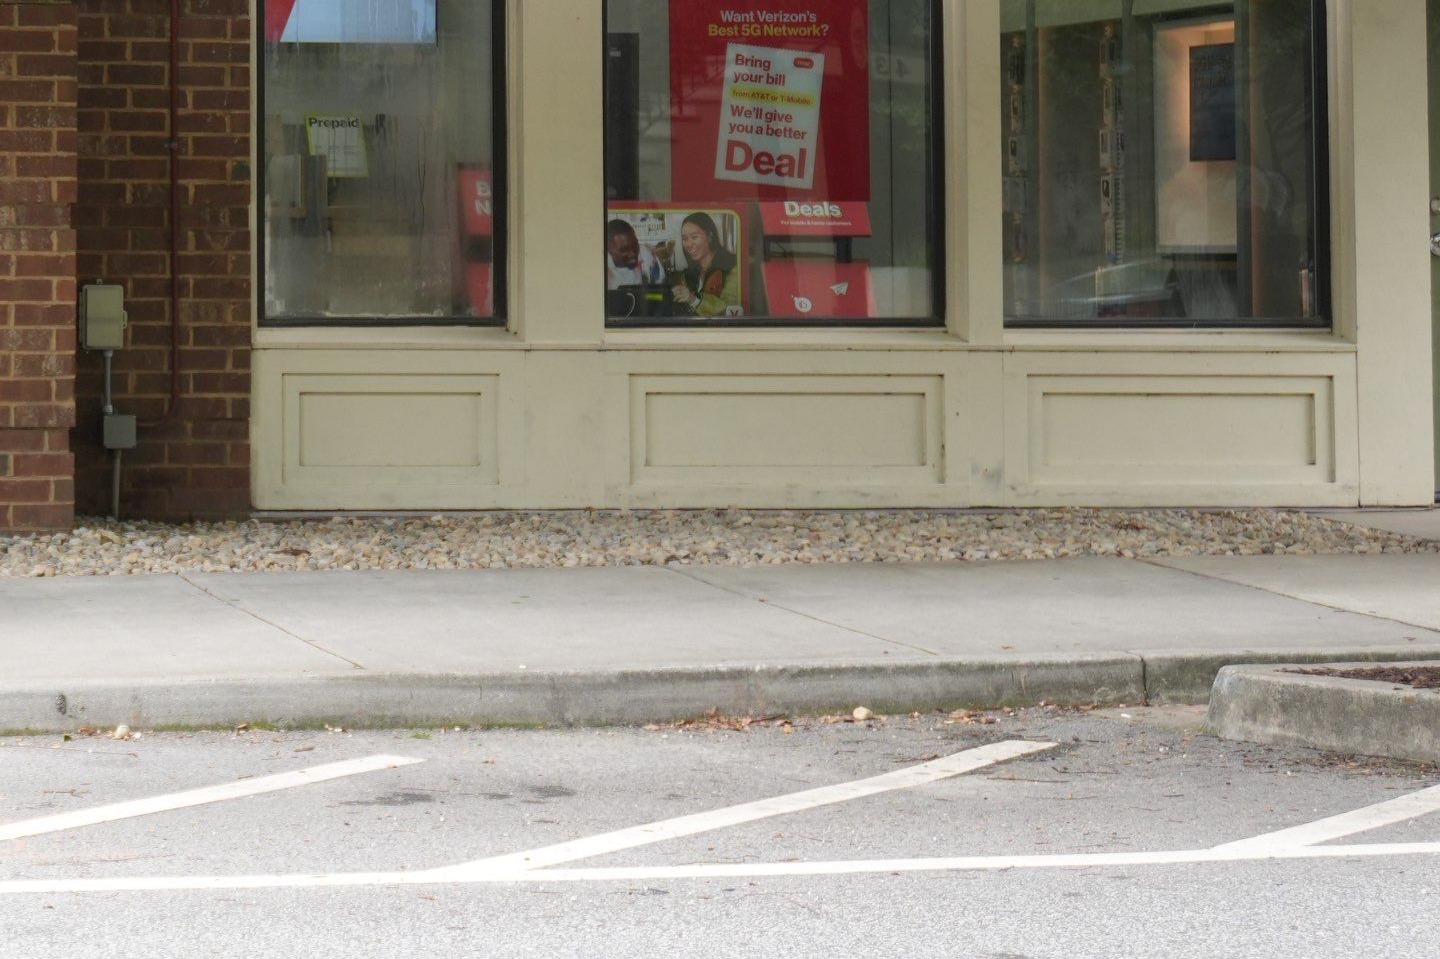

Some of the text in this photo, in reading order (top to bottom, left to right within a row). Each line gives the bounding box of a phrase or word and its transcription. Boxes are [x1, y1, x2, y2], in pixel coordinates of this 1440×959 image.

[720, 10, 817, 22] Want Verizon's
[708, 24, 829, 36] Best 5G Network?
[735, 53, 771, 71] Bring
[734, 72, 786, 86] your bill
[732, 90, 752, 98] from
[731, 104, 793, 123] We'll give
[308, 117, 360, 129] Prepaid
[728, 123, 807, 139] you a better
[725, 140, 807, 178] Deal
[784, 201, 842, 217] Deals
